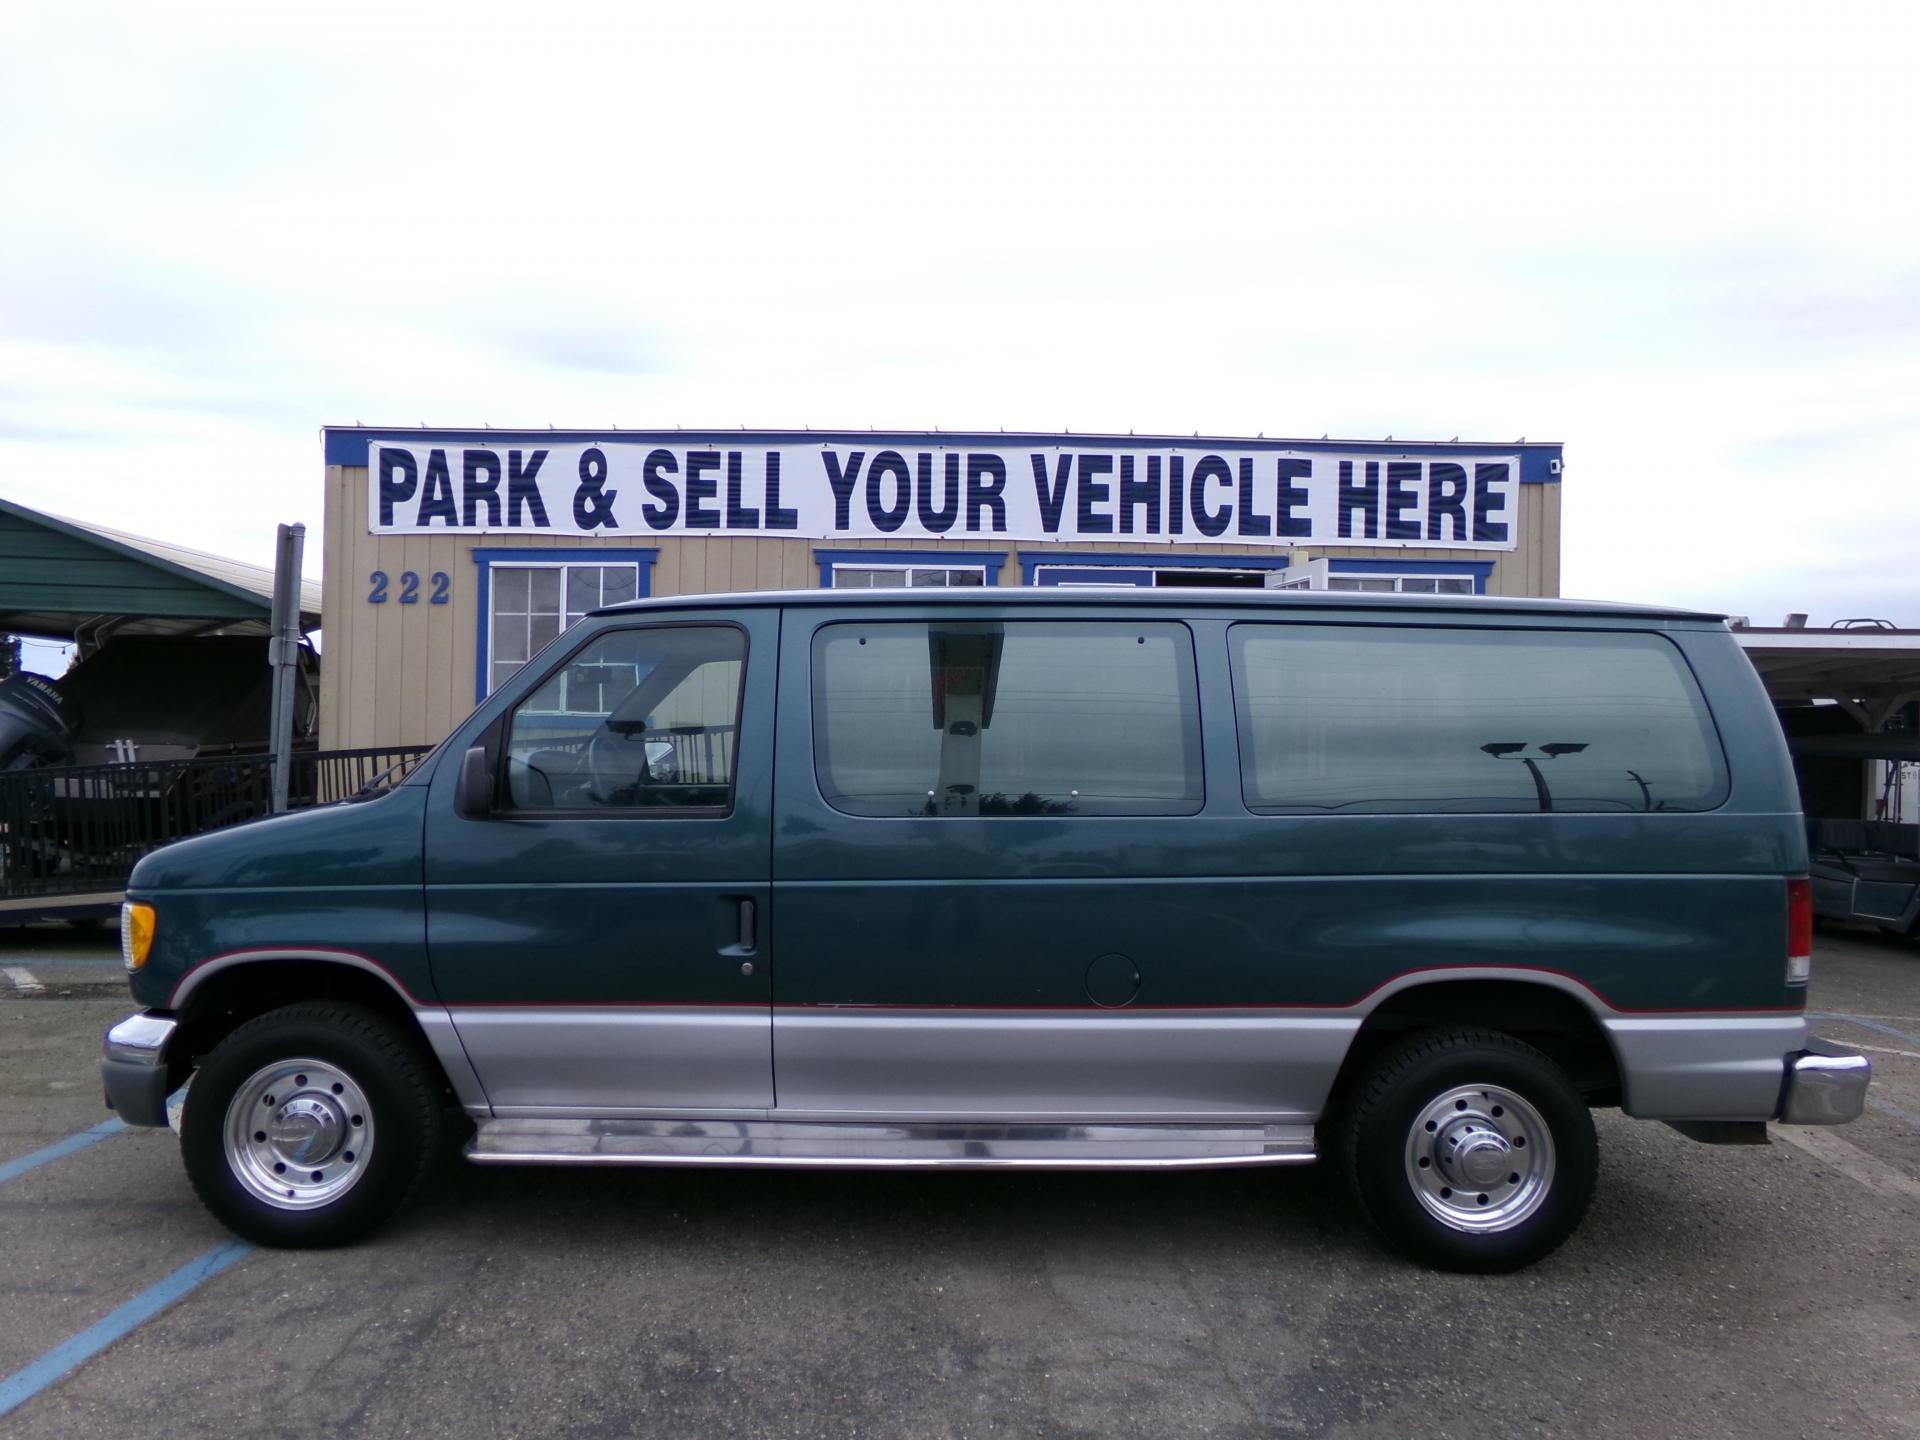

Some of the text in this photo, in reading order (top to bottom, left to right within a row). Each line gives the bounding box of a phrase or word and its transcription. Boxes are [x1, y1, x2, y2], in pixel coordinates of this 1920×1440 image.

[379, 447, 1510, 542] PARK & SELL YOUR VEHICLE HERE
[367, 570, 450, 604] 222
[26, 676, 64, 705] YAMAHA
